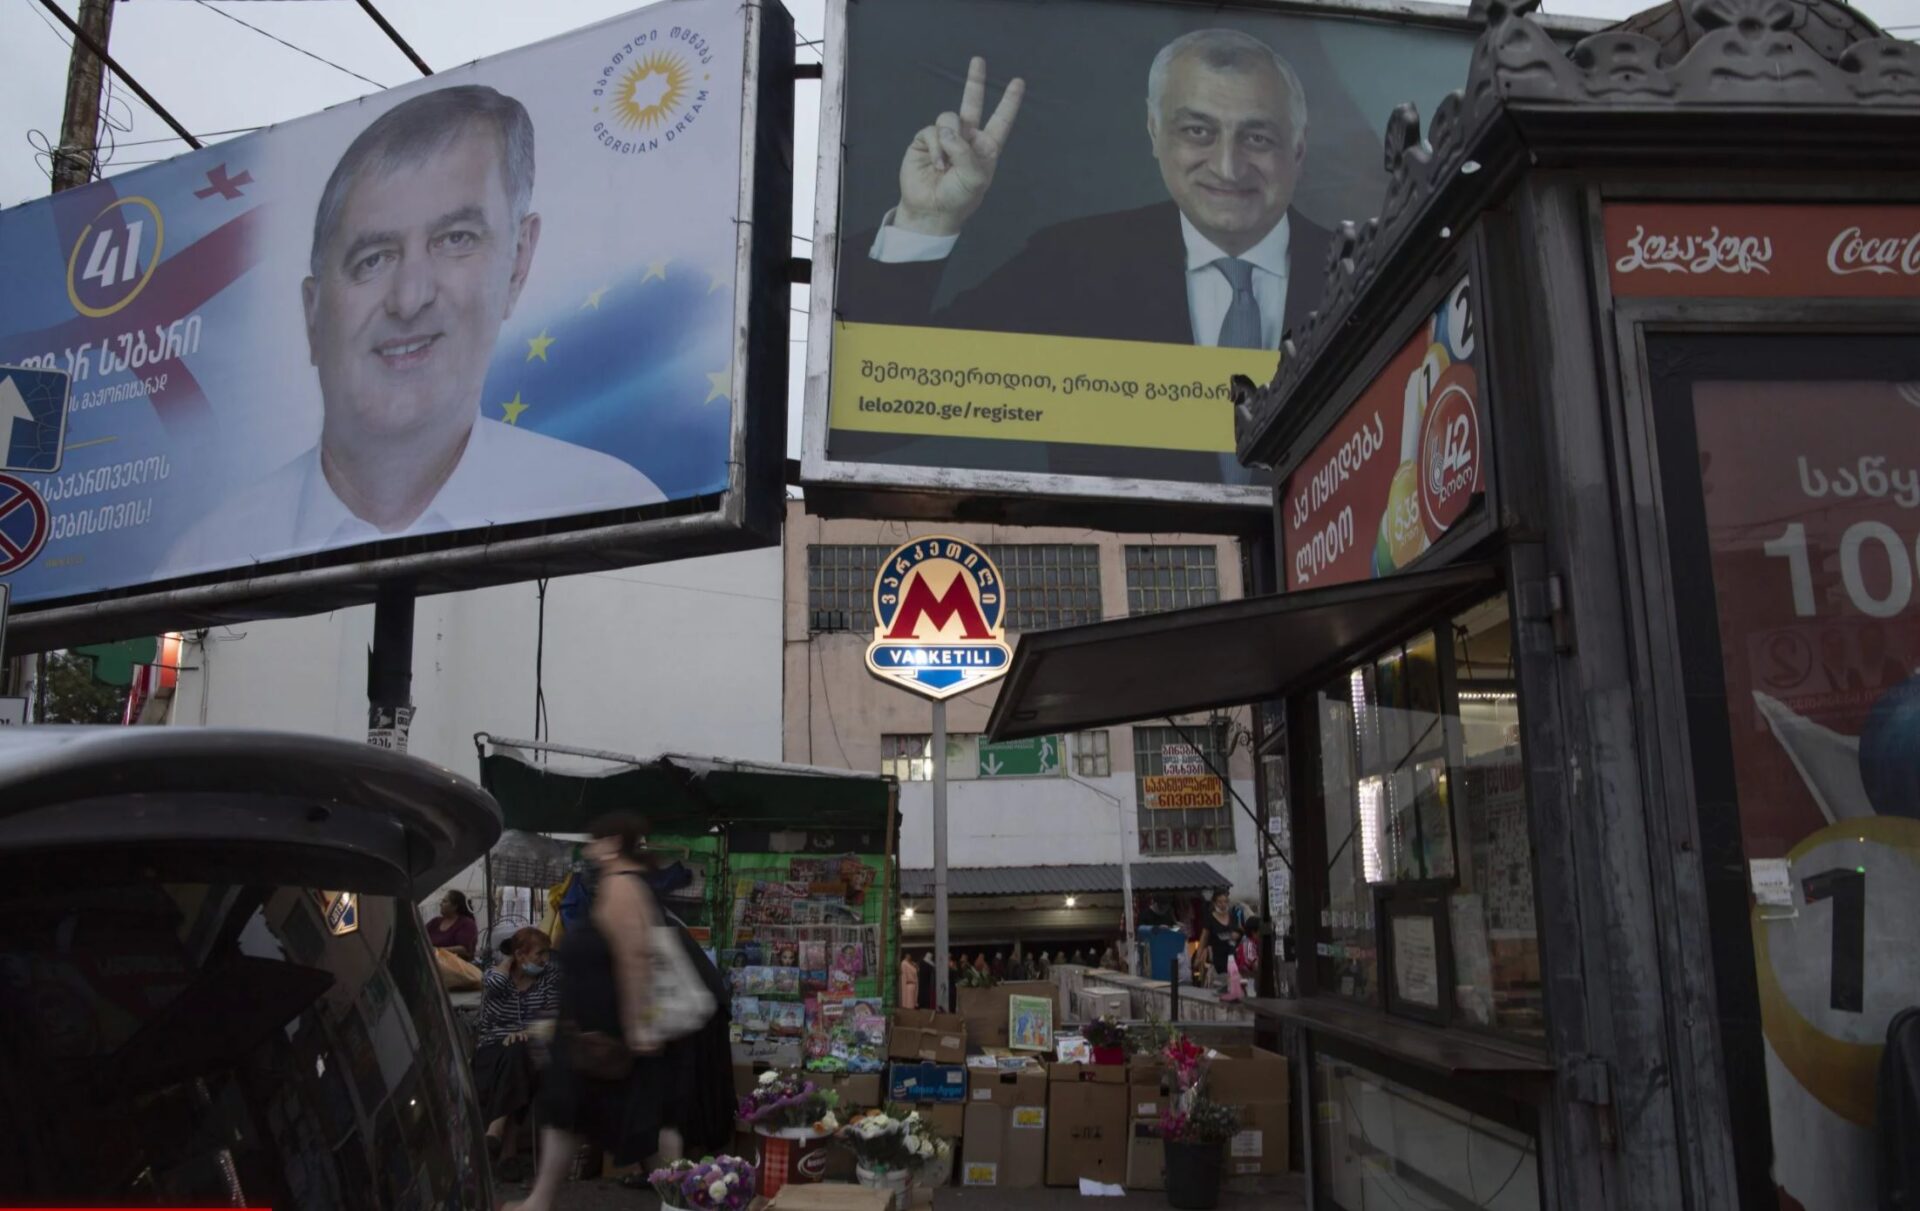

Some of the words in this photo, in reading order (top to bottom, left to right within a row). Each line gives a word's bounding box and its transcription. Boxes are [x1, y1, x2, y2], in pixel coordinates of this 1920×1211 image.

[593, 121, 659, 154] GEORGIAN
[665, 89, 710, 142] DREAM
[83, 219, 145, 288] 41
[98, 314, 202, 376] სუბარი
[81, 373, 169, 411] მაჟორიტარად
[858, 395, 1044, 424] lelo2020.ge/register
[860, 359, 1057, 393] შემოგვიერთდით,
[1062, 373, 1139, 399] ერთად
[43, 455, 171, 502] საქართველოს
[881, 541, 997, 605] ვარკეთილი
[1295, 504, 1354, 584] ლოტო
[1763, 519, 1920, 618] 10
[1158, 792, 1221, 807] ნივთები
[1139, 828, 1216, 850] XEROX
[1801, 866, 1867, 1013] 1
